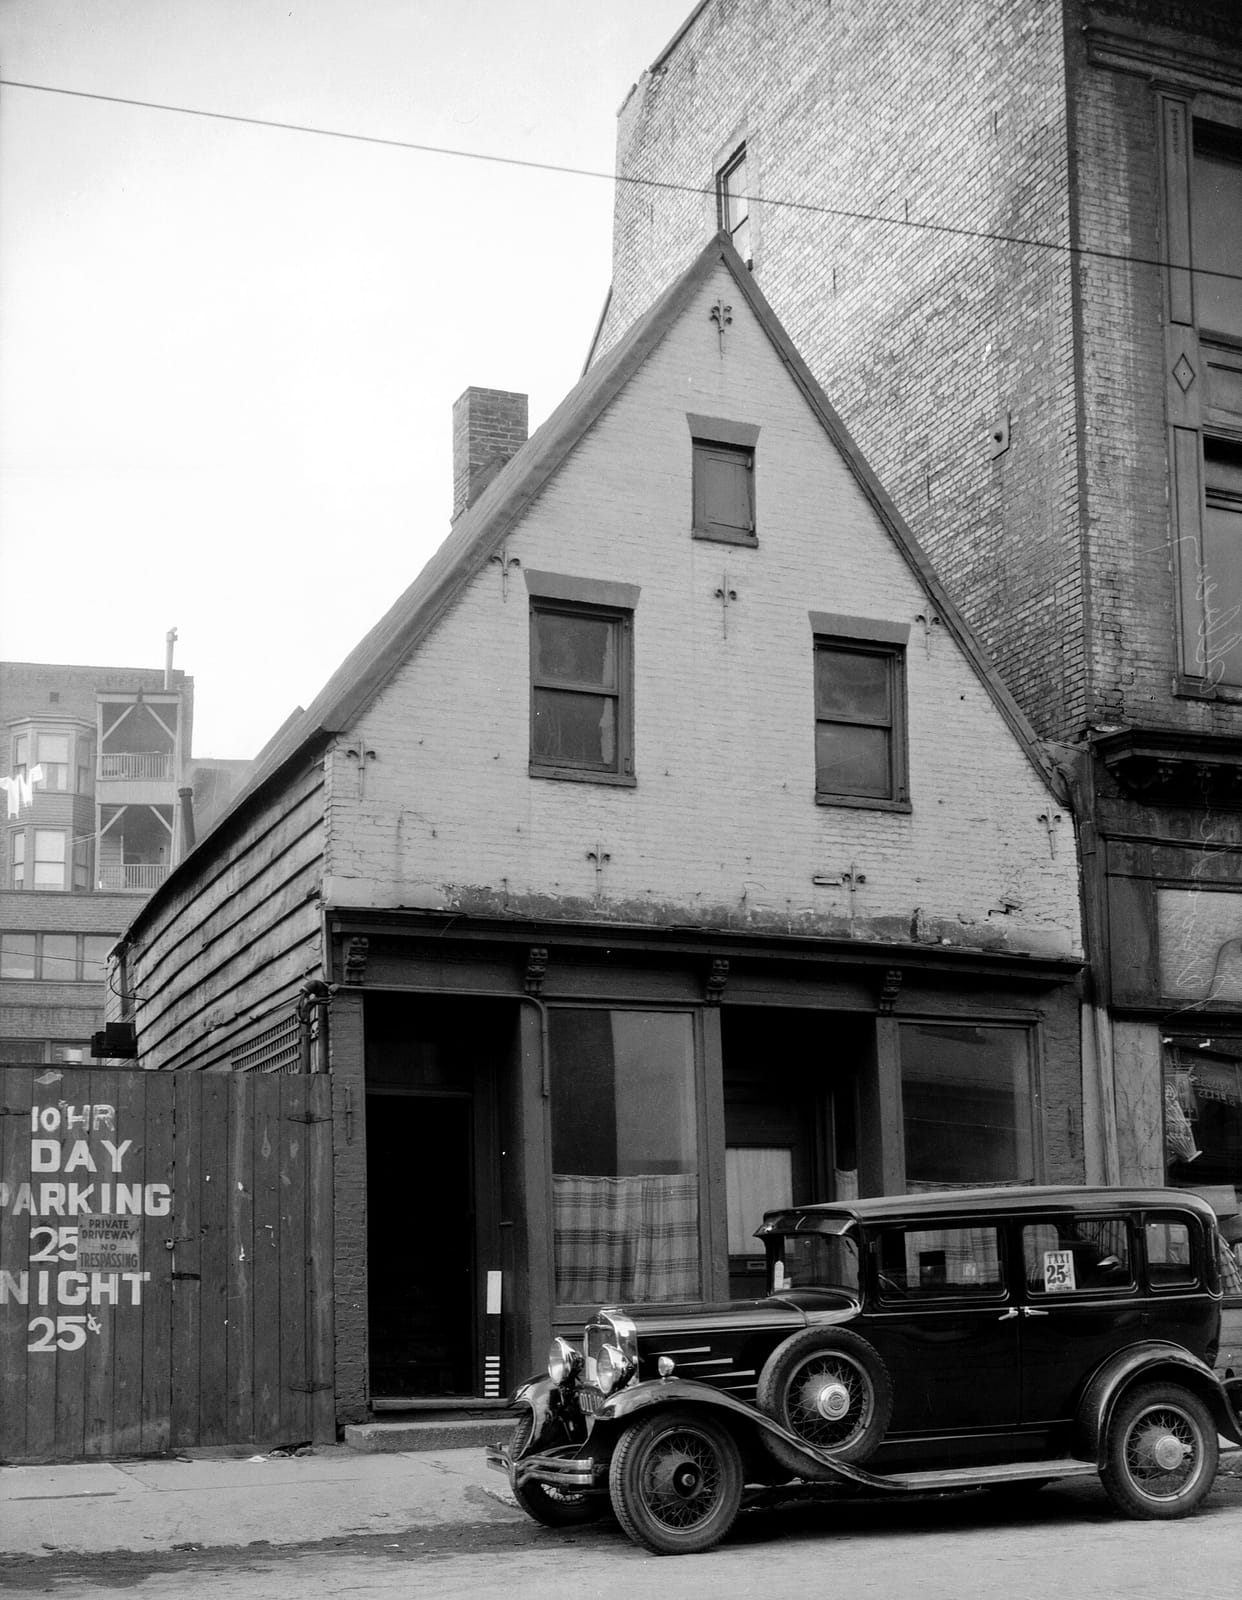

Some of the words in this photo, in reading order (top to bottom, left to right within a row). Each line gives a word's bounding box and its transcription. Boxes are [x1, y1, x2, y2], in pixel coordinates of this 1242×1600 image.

[31, 1140, 133, 1172] DAY
[89, 1219, 130, 1229] PRIVATE
[81, 1230, 136, 1240] DRIVEWAY
[29, 1226, 78, 1262] 25
[100, 1243, 118, 1251] NO
[80, 1252, 139, 1268] TRESPASSING
[1047, 1253, 1070, 1264] TAXI
[0, 1271, 151, 1305] NIGHT
